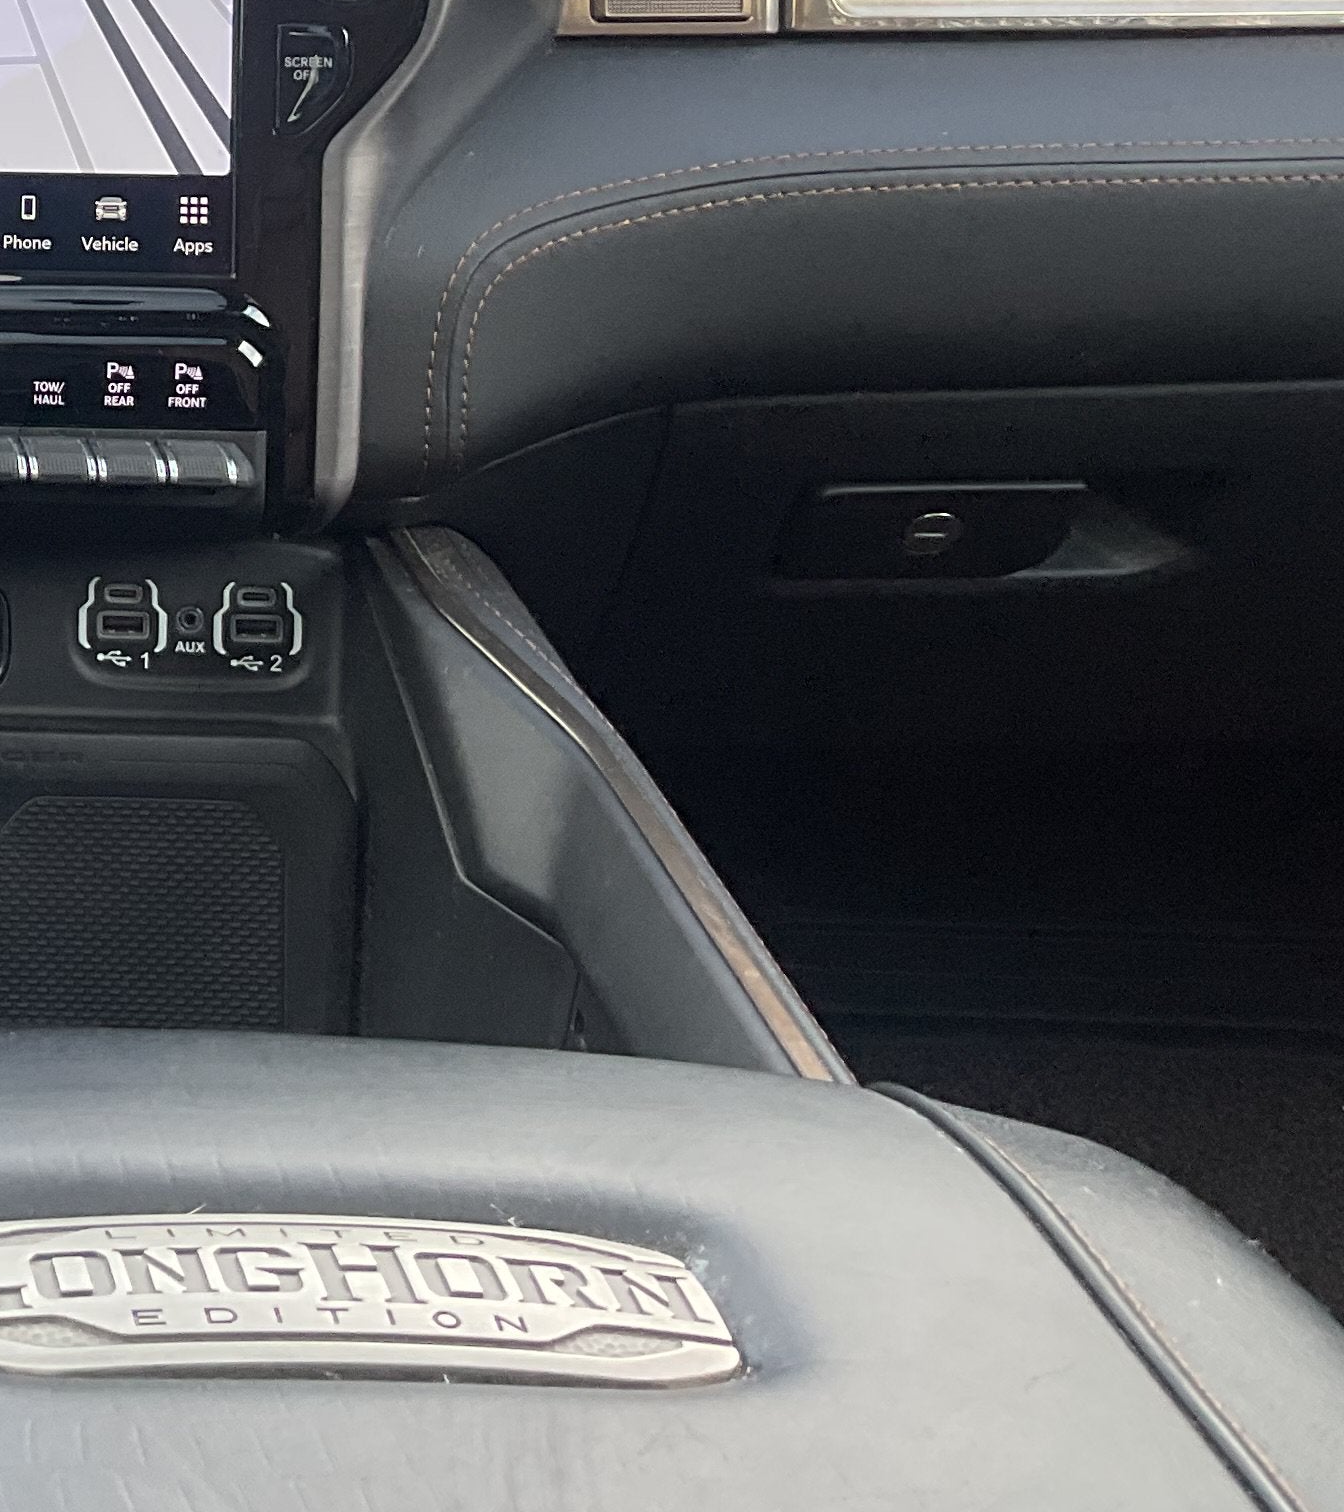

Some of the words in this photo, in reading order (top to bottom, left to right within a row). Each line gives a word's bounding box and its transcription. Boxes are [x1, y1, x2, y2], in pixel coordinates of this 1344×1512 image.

[284, 56, 333, 68] SCREEN
[2, 234, 52, 250] Phone
[81, 236, 139, 252] Vehicle
[173, 237, 213, 256] Apps
[33, 380, 65, 395] TOW/
[107, 381, 131, 394] OFF
[175, 382, 199, 395] OFF
[33, 394, 65, 406] HAUL
[103, 394, 135, 407] REAR
[167, 395, 207, 408] FRONT
[175, 641, 206, 653] AUX
[140, 652, 150, 669] 1
[270, 655, 282, 672] 2
[104, 1227, 486, 1247] LIMITED
[132, 1306, 531, 1333] EDITION
